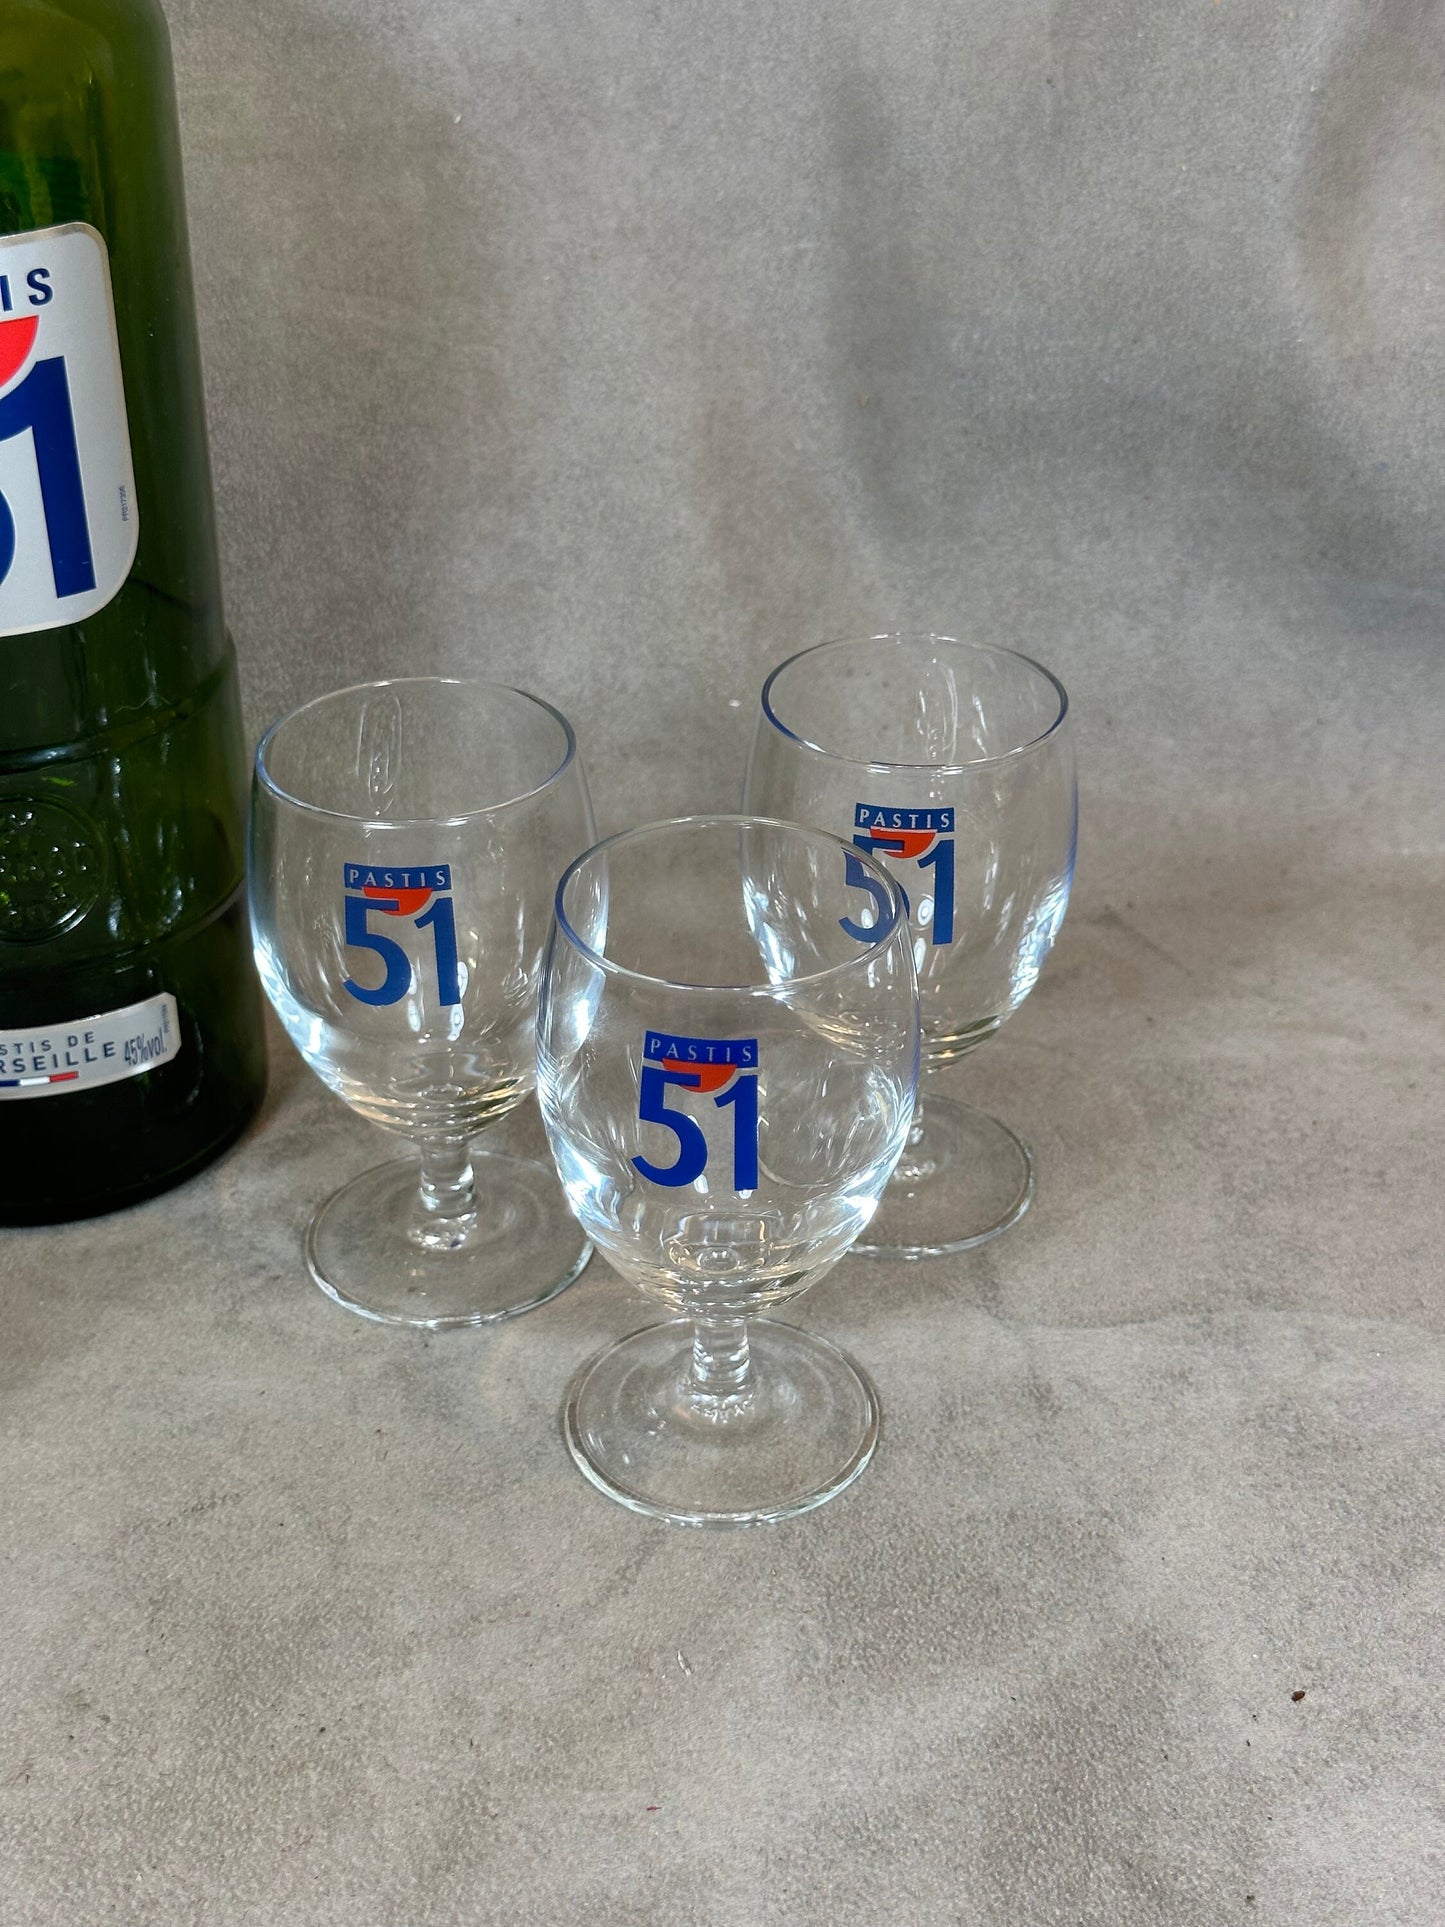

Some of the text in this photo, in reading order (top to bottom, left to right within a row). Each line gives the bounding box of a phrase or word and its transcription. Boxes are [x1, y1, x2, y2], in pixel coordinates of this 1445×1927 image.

[0, 356, 97, 598] 1
[860, 808, 950, 829] PASTIS
[350, 869, 446, 888] PASTIS
[839, 834, 955, 945] 51
[343, 895, 461, 1006] 51
[68, 1031, 96, 1048] DE
[650, 1038, 752, 1063] PASTIS
[631, 1066, 759, 1191] 51
